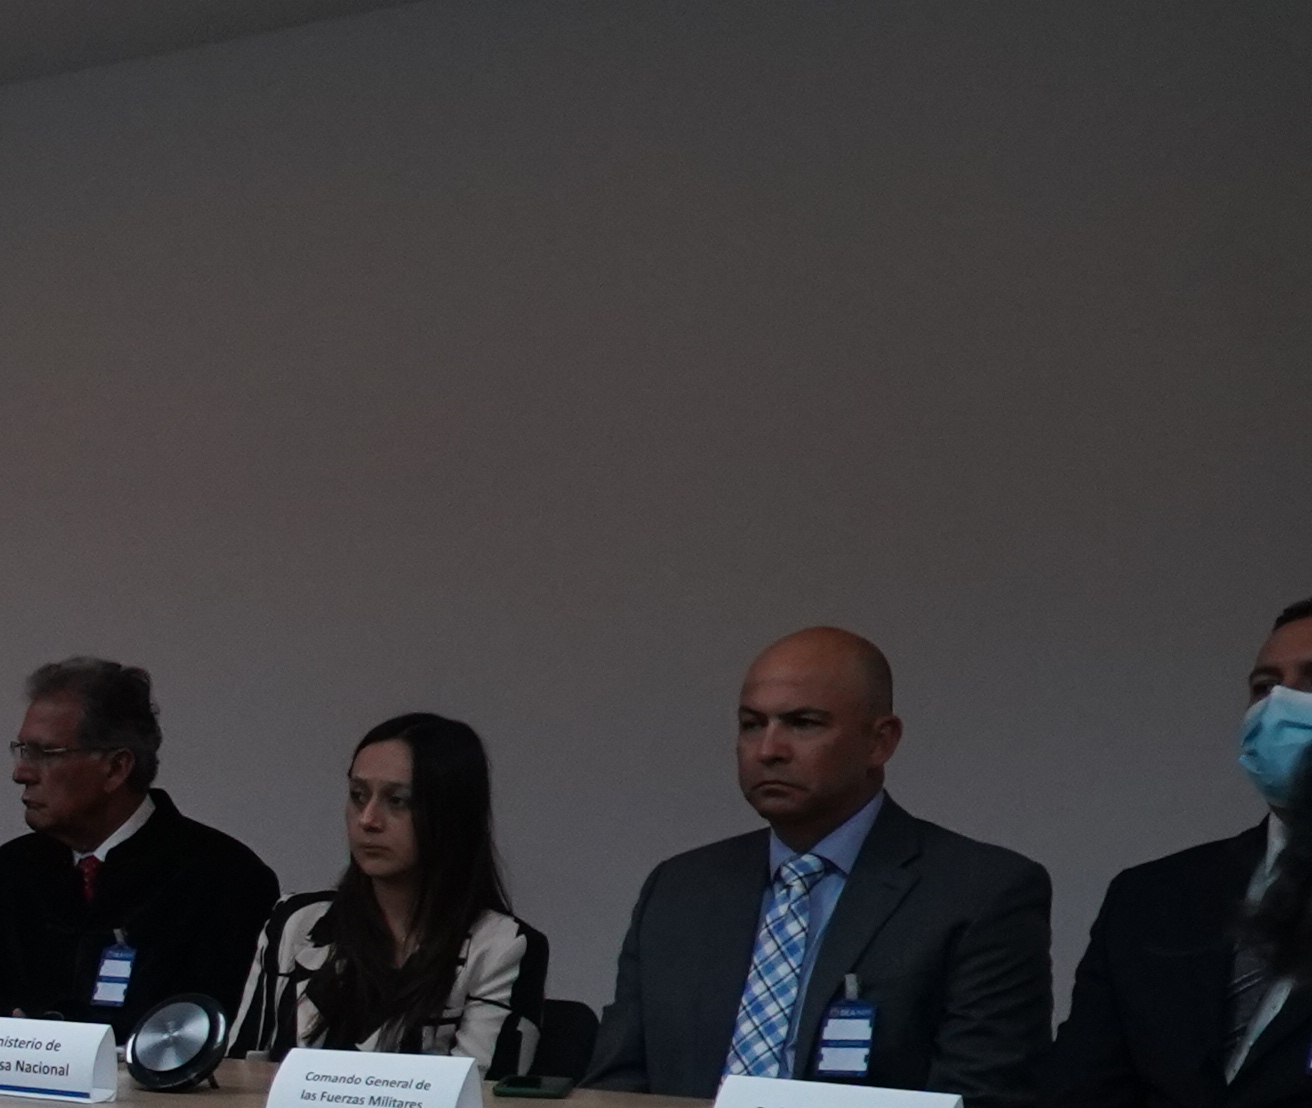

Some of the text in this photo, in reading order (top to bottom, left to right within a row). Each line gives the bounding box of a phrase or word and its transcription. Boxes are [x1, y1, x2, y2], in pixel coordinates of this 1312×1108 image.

[45, 1038, 62, 1052] de
[15, 1060, 70, 1077] Nacional
[304, 1071, 432, 1091] Comando General de
[300, 1089, 317, 1101] las
[320, 1092, 365, 1106] Fuerzas
